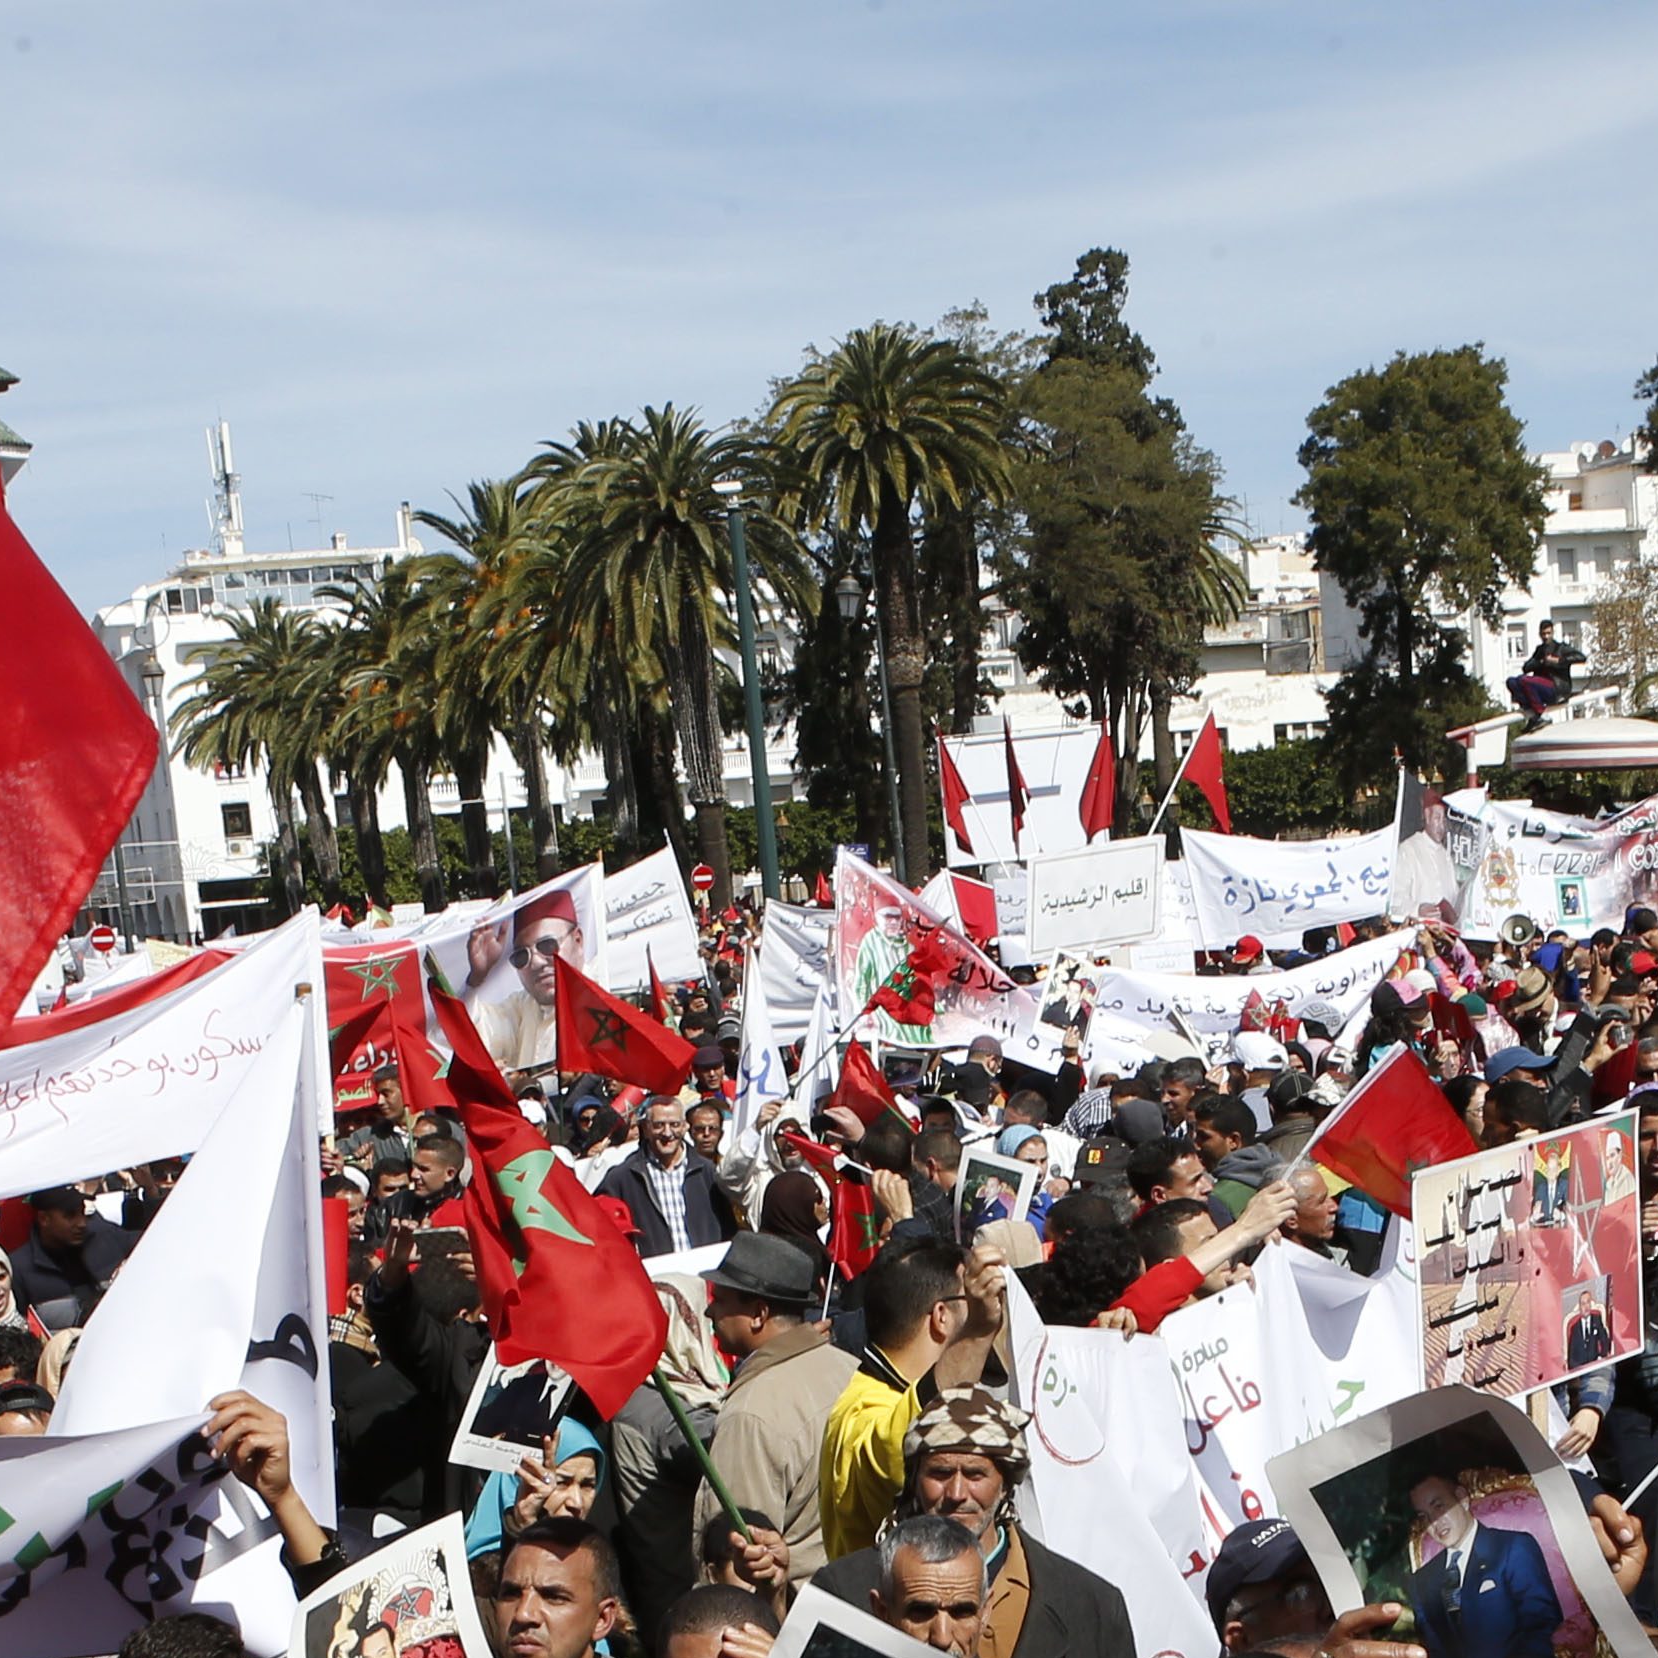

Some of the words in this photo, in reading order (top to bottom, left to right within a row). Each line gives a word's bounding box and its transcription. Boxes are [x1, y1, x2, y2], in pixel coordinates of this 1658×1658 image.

[1040, 882, 1109, 918] الرشيدية
[1111, 877, 1149, 909] إقليم
[334, 1078, 374, 1108] الصحر
[1181, 1336, 1229, 1374] مبادرة
